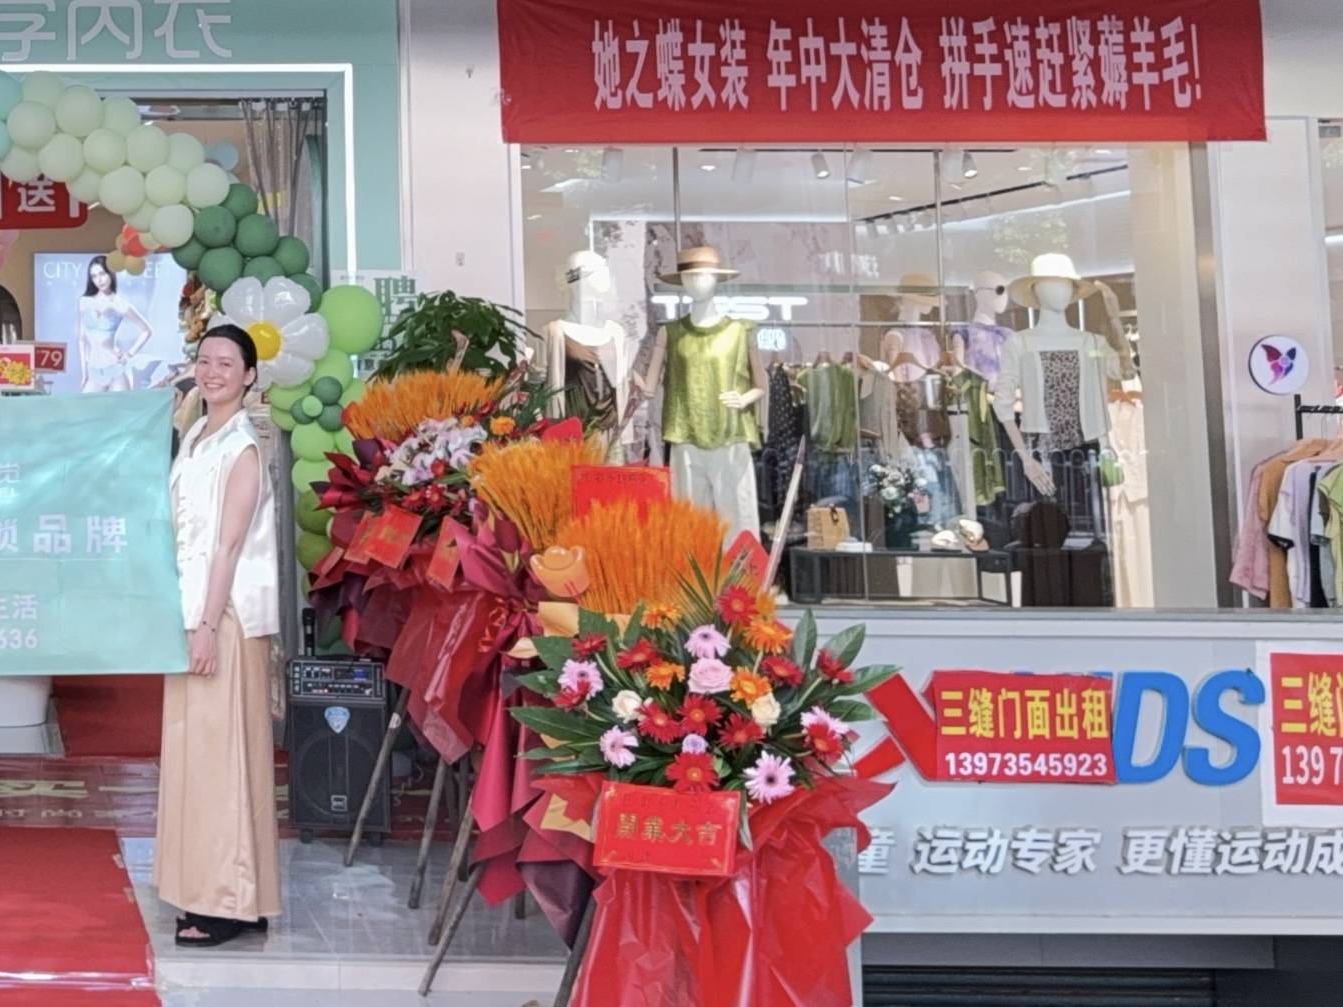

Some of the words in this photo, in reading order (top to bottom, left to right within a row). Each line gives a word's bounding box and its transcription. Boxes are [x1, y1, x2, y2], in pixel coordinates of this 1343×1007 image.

[591, 17, 750, 112] 她之蝶女装
[766, 16, 924, 112] 年中大清仓
[939, 687, 1110, 740] 三缝门面出租
[1280, 672, 1343, 738] 三缝
[944, 752, 1108, 778] 13973545923
[910, 827, 1103, 876] 运动专家
